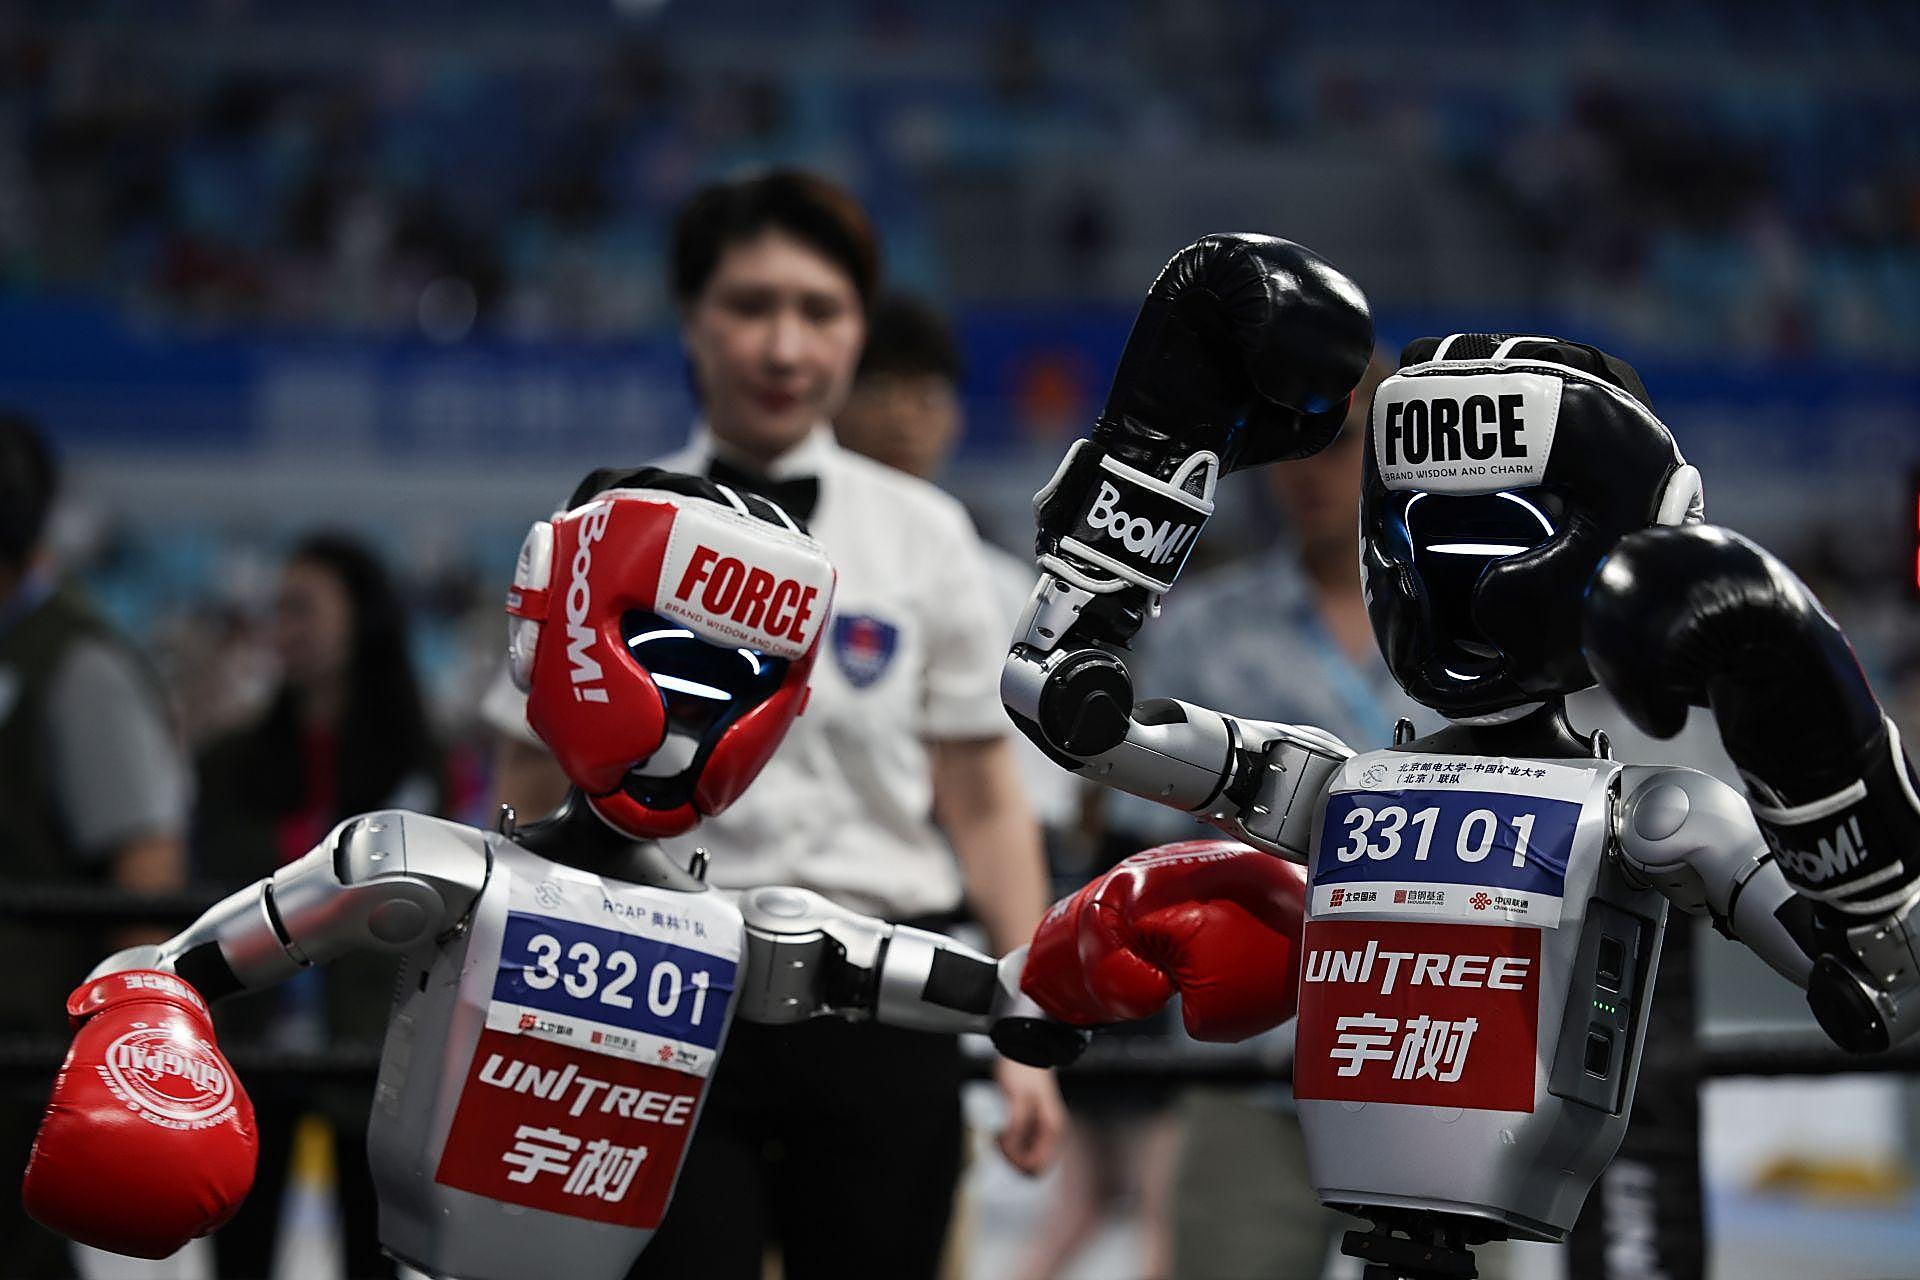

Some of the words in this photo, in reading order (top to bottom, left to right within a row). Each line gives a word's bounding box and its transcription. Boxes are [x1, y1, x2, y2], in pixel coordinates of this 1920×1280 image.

[1385, 394, 1527, 465] FORCE
[1385, 471, 1413, 482] BRAND
[1416, 468, 1457, 479] WISDOM
[1461, 466, 1486, 476] AND
[1490, 464, 1533, 475] CHARM
[664, 602, 703, 624] BRAND
[706, 619, 749, 641] WISDOM
[751, 636, 773, 650] AND
[675, 544, 818, 644] FORCE
[1337, 806, 1441, 863] 331
[1456, 808, 1536, 868] 01
[1494, 896, 1528, 909] 中国联通
[523, 934, 638, 1010] 332
[648, 961, 710, 1026] 01
[1305, 940, 1531, 995] UNITREE
[1329, 1013, 1479, 1082] 宇树
[478, 1054, 695, 1125] UNITREE
[502, 1125, 648, 1202] 宇树
